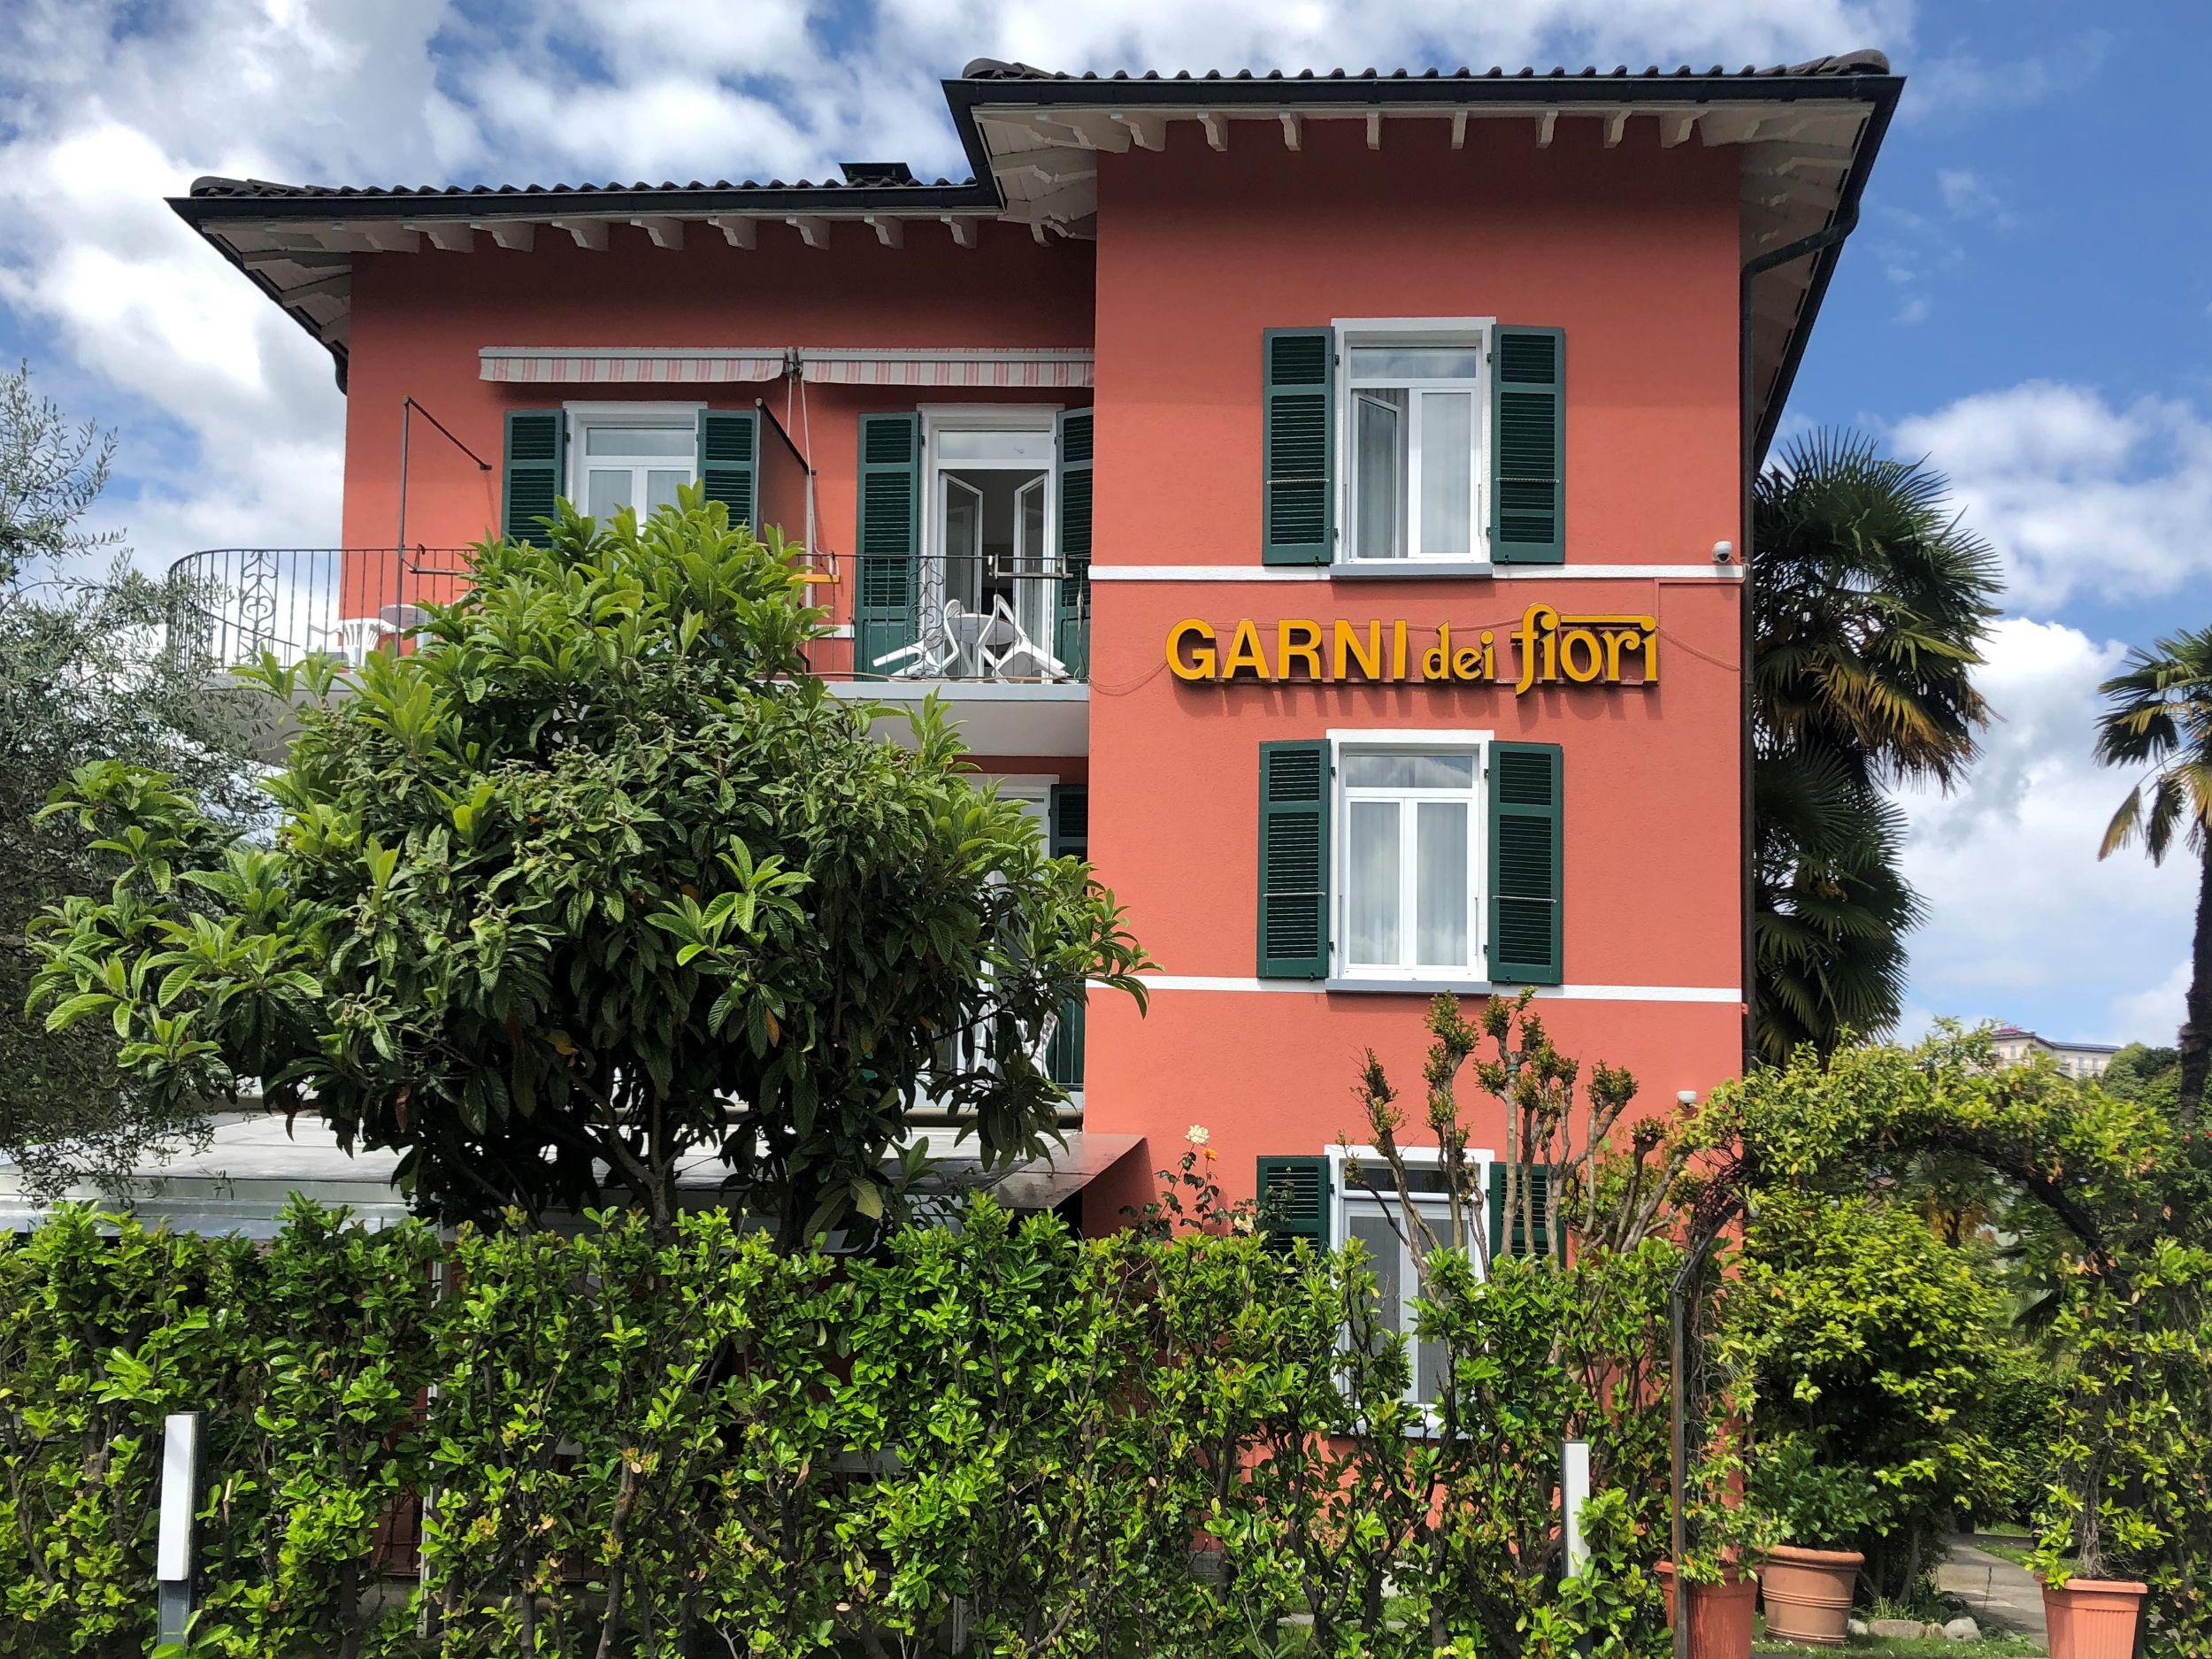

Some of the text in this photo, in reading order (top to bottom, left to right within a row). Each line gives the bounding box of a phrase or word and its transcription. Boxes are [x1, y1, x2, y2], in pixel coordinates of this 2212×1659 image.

[1165, 603, 1658, 696] GARNI dei fiori
